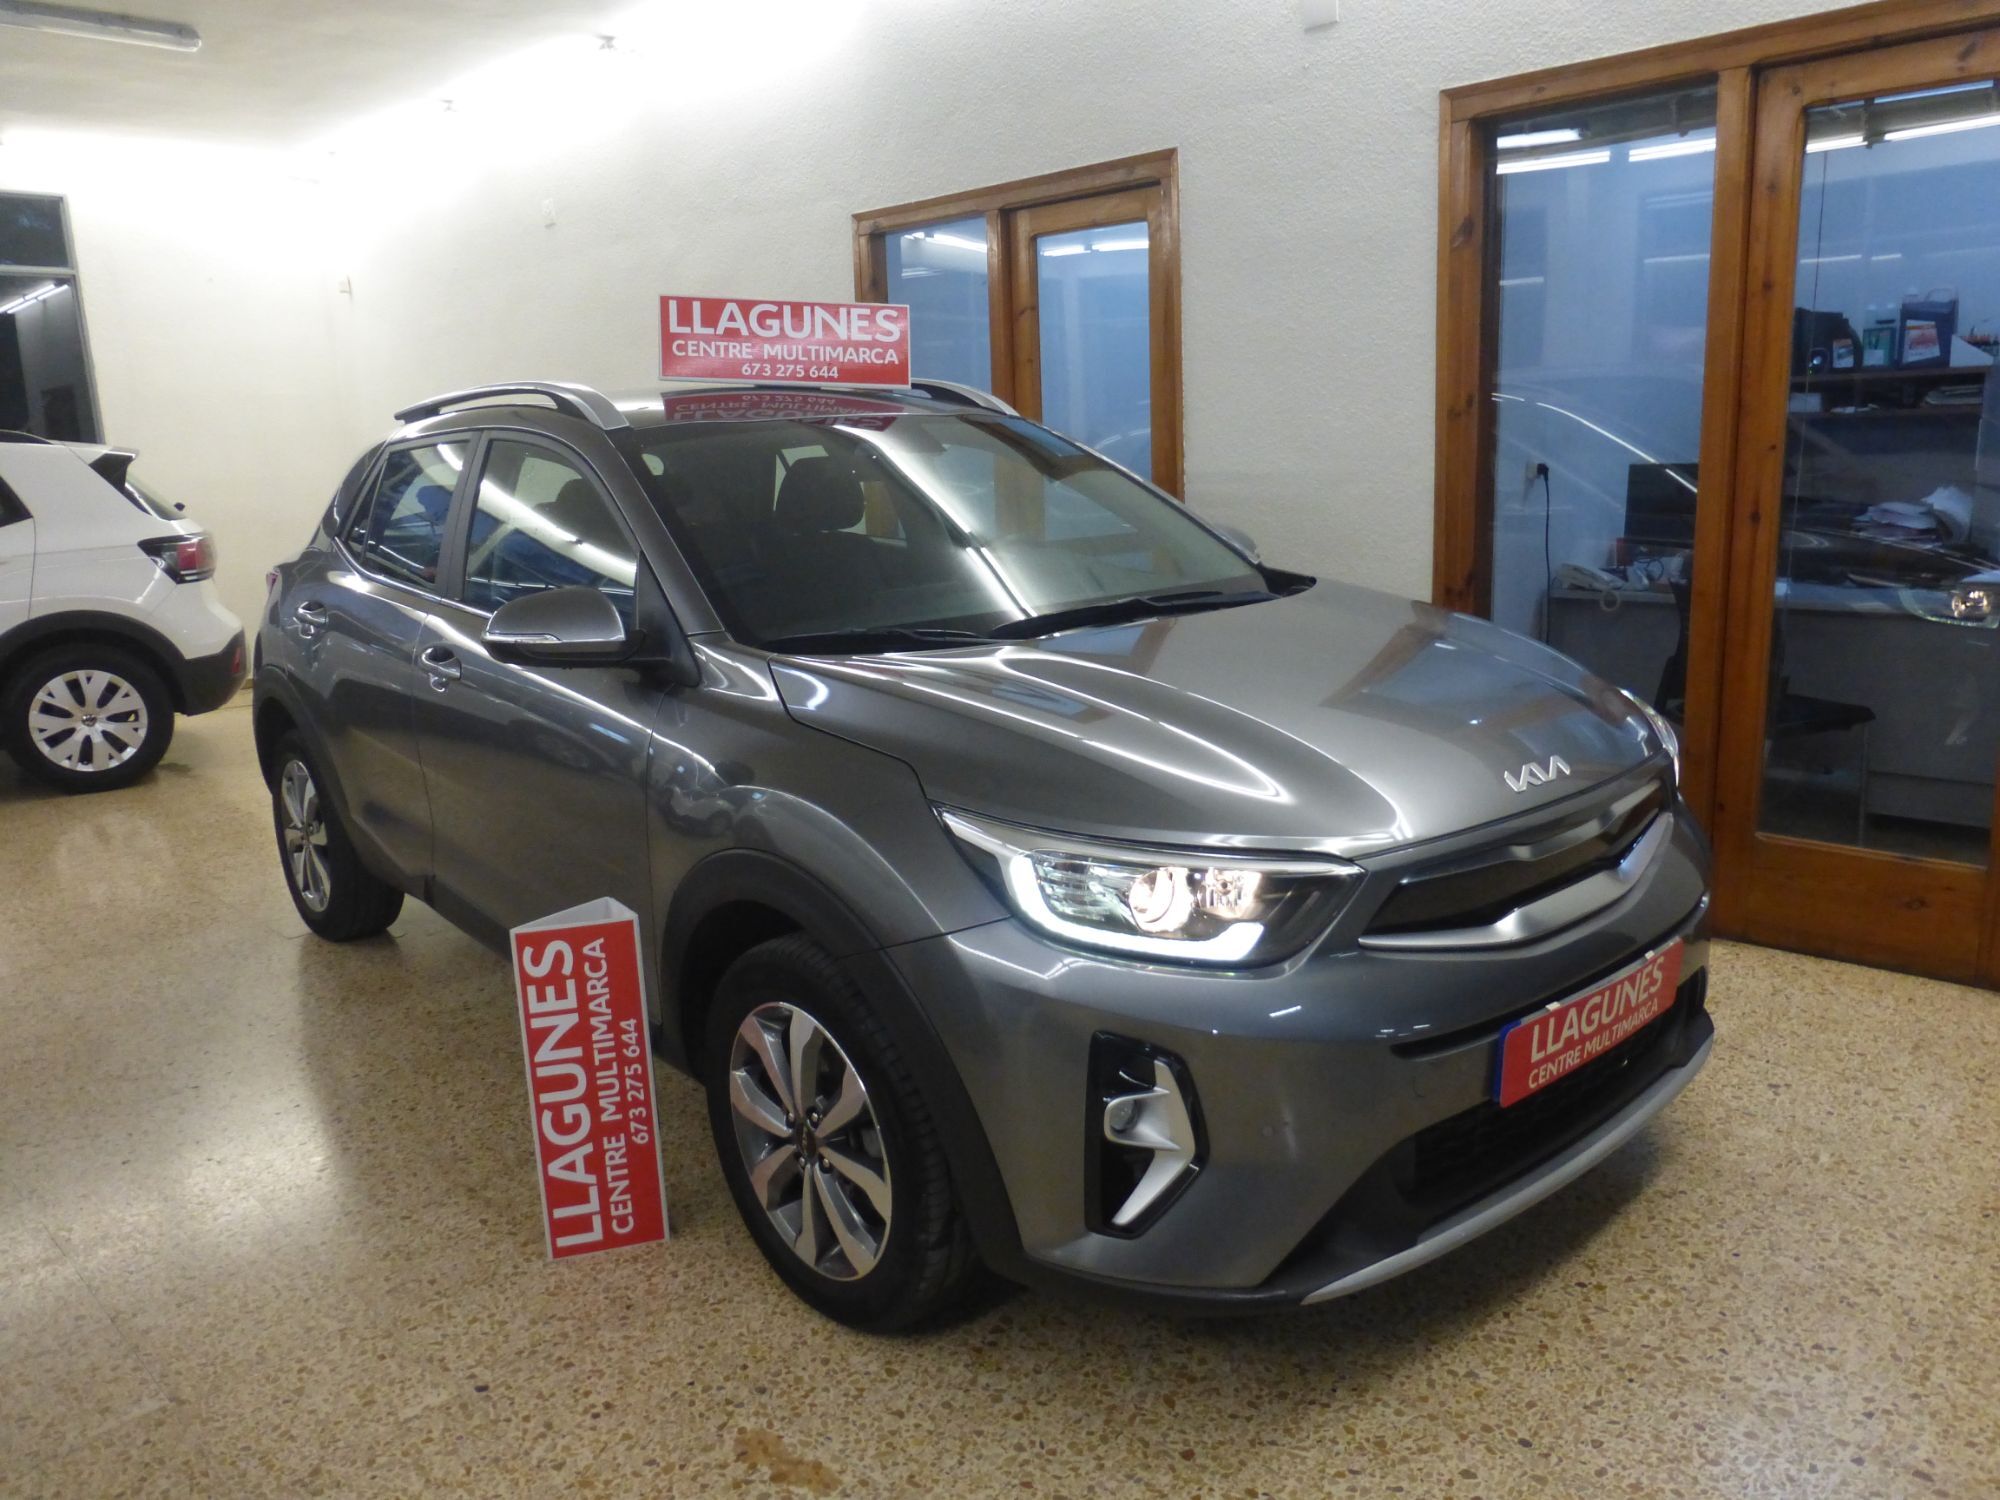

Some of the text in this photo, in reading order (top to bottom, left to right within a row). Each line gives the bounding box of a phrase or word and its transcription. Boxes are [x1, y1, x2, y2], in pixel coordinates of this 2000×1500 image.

[668, 299, 901, 343] LLAGUNES
[672, 339, 899, 365] CENTRE MULTIMARCA
[741, 363, 839, 379] 673 275 644
[1528, 997, 1659, 1089] CENTRE MULTIMARCA
[1530, 955, 1664, 1064] LLAGUNES
[522, 938, 604, 1248] LLAGUNES
[582, 936, 635, 1235] CENTRE MULTIMARCA
[619, 1018, 649, 1145] 673 275 644
